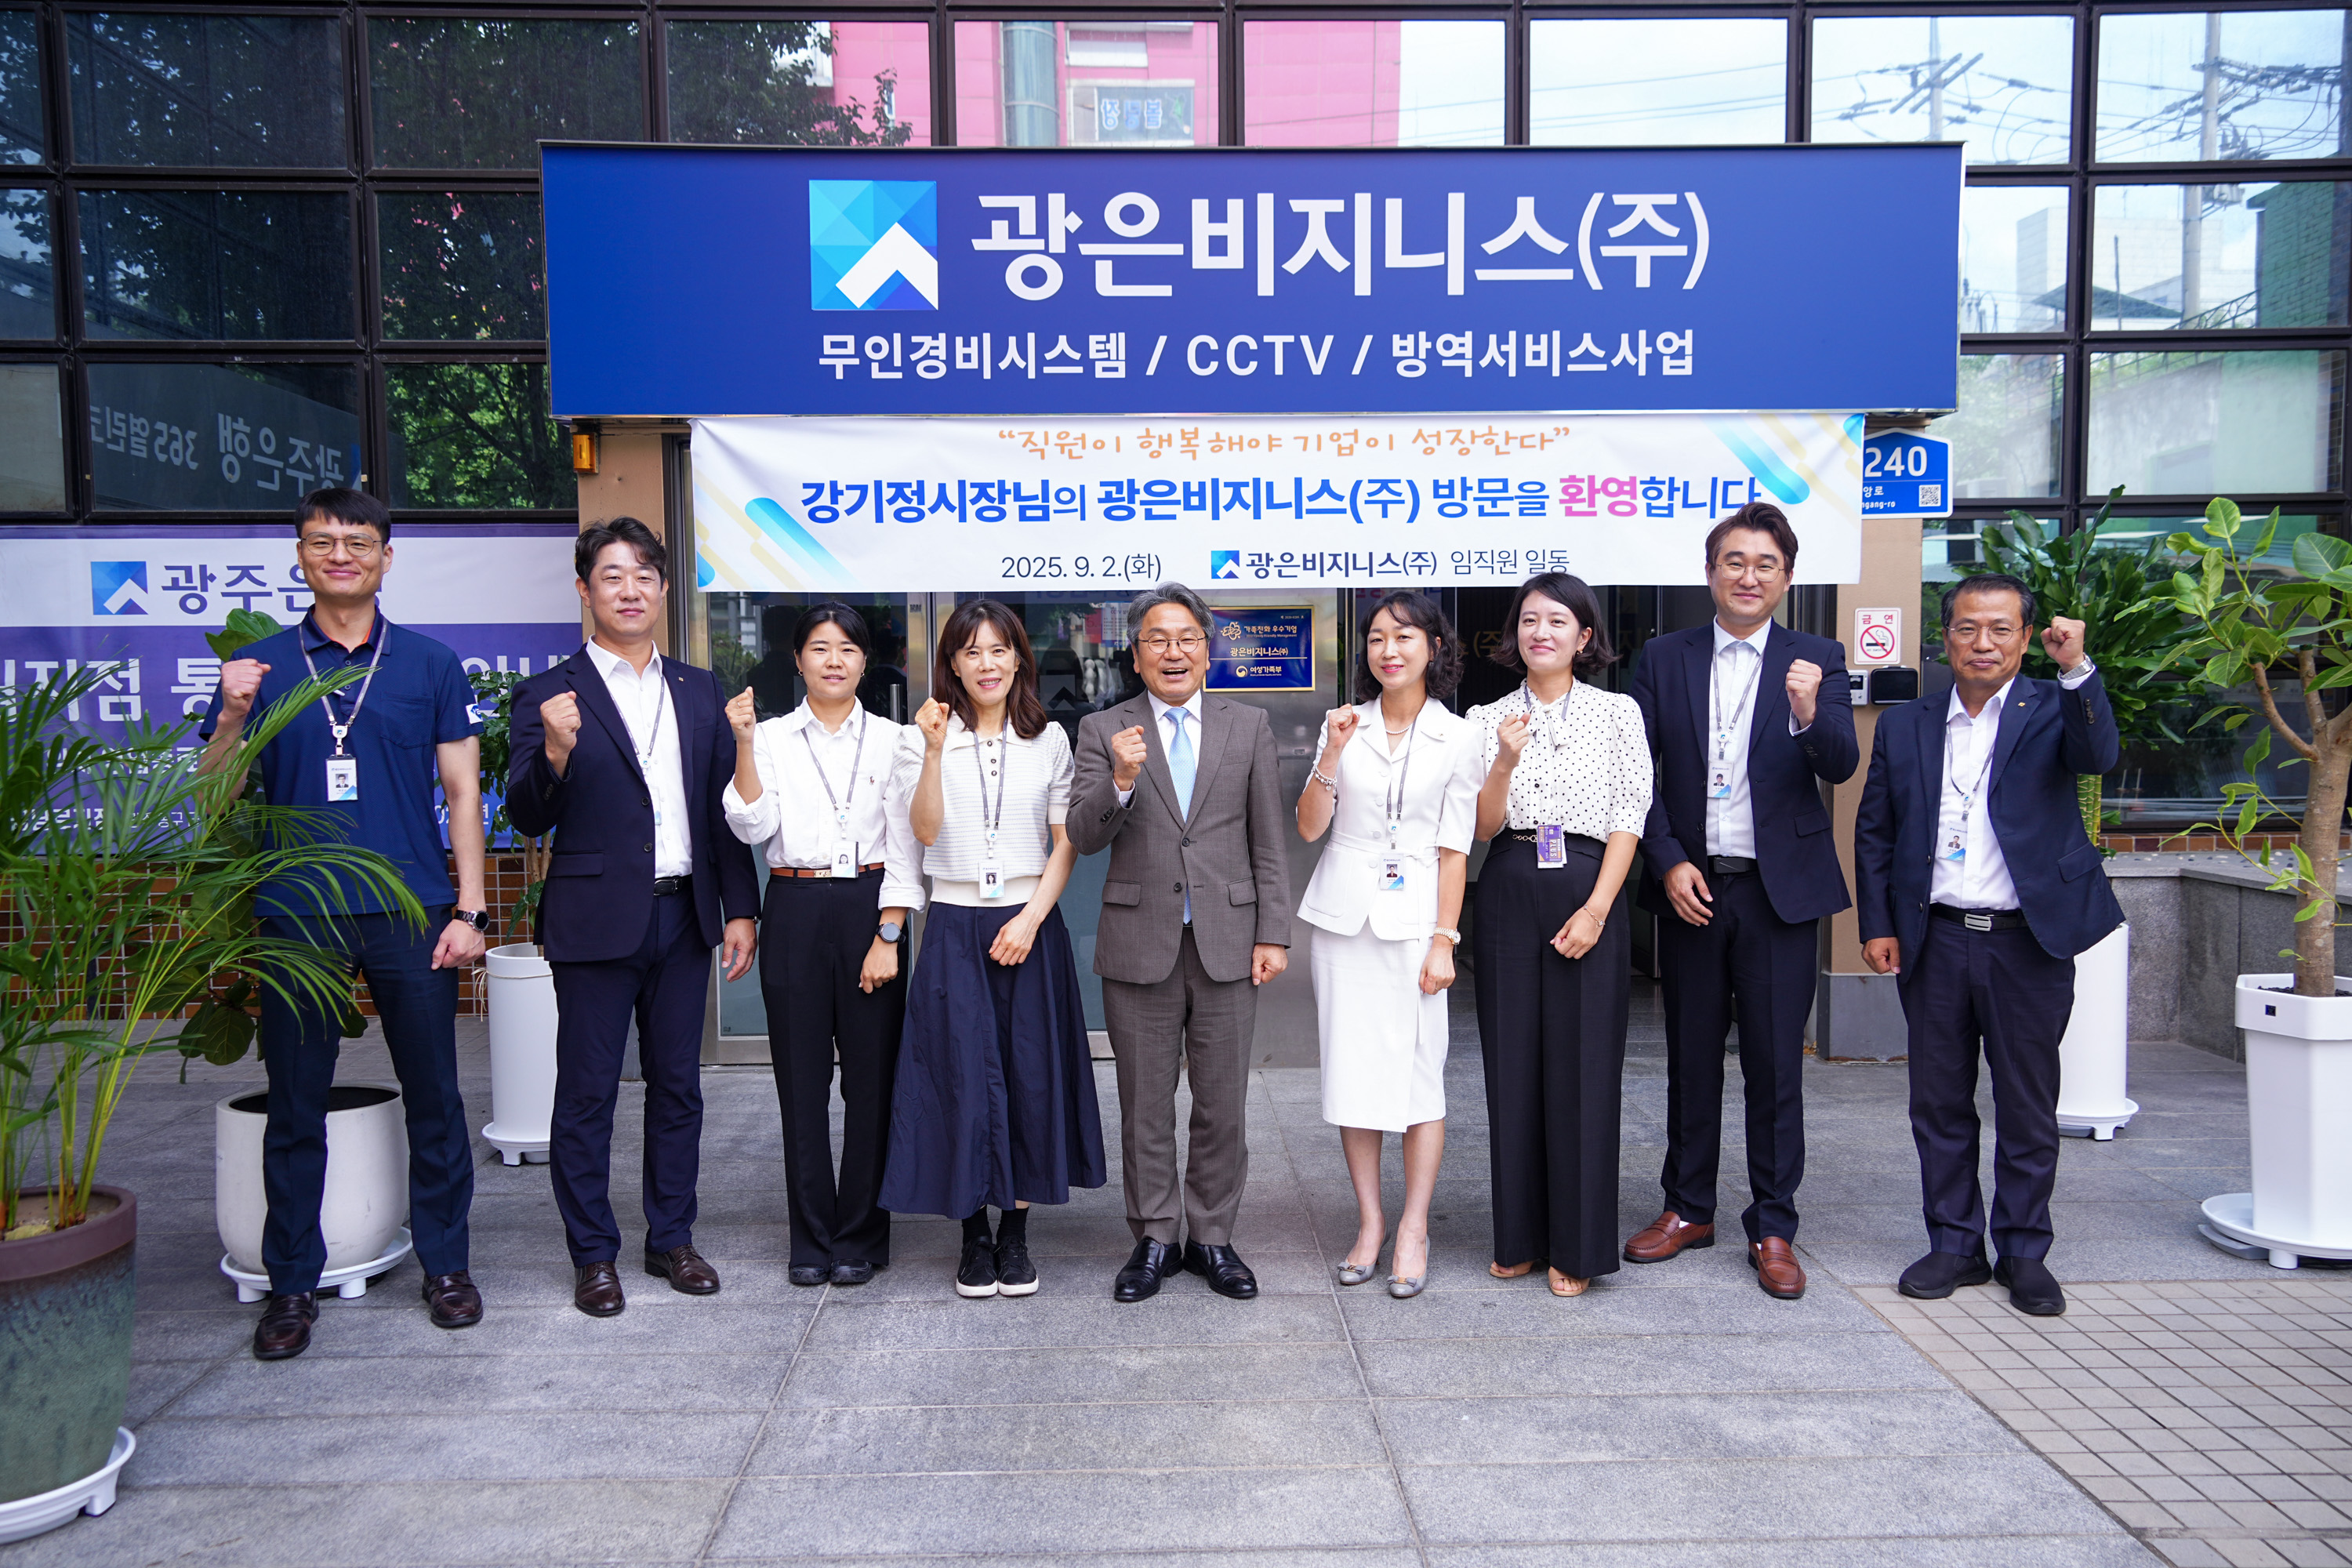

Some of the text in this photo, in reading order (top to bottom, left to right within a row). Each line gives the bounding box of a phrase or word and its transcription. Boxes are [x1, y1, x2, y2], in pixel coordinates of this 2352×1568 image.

[971, 191, 1710, 301] 광은비지니스(주)
[819, 332, 1126, 379] 무인경비시스템
[1187, 334, 1334, 376] CCTV
[1392, 329, 1693, 378] 방역서비스사업
[1294, 429, 1394, 457] 기업이
[1864, 445, 1927, 477] 240
[801, 475, 1762, 524] 강기정시장님의 광은비지니스(주) 방문을 환영합니다
[1862, 485, 1884, 498] 앙로
[1862, 501, 1896, 510] ngang-ro
[1001, 556, 1068, 578] 2025.
[1074, 557, 1094, 578] 9.
[1246, 551, 1438, 579] 광은비지니스(주)
[1450, 550, 1518, 575] 임직원
[1526, 549, 1570, 574] 일동
[162, 564, 382, 615] 광주은
[1272, 625, 1298, 633] 우수기업
[1250, 666, 1283, 674] 여성가족부
